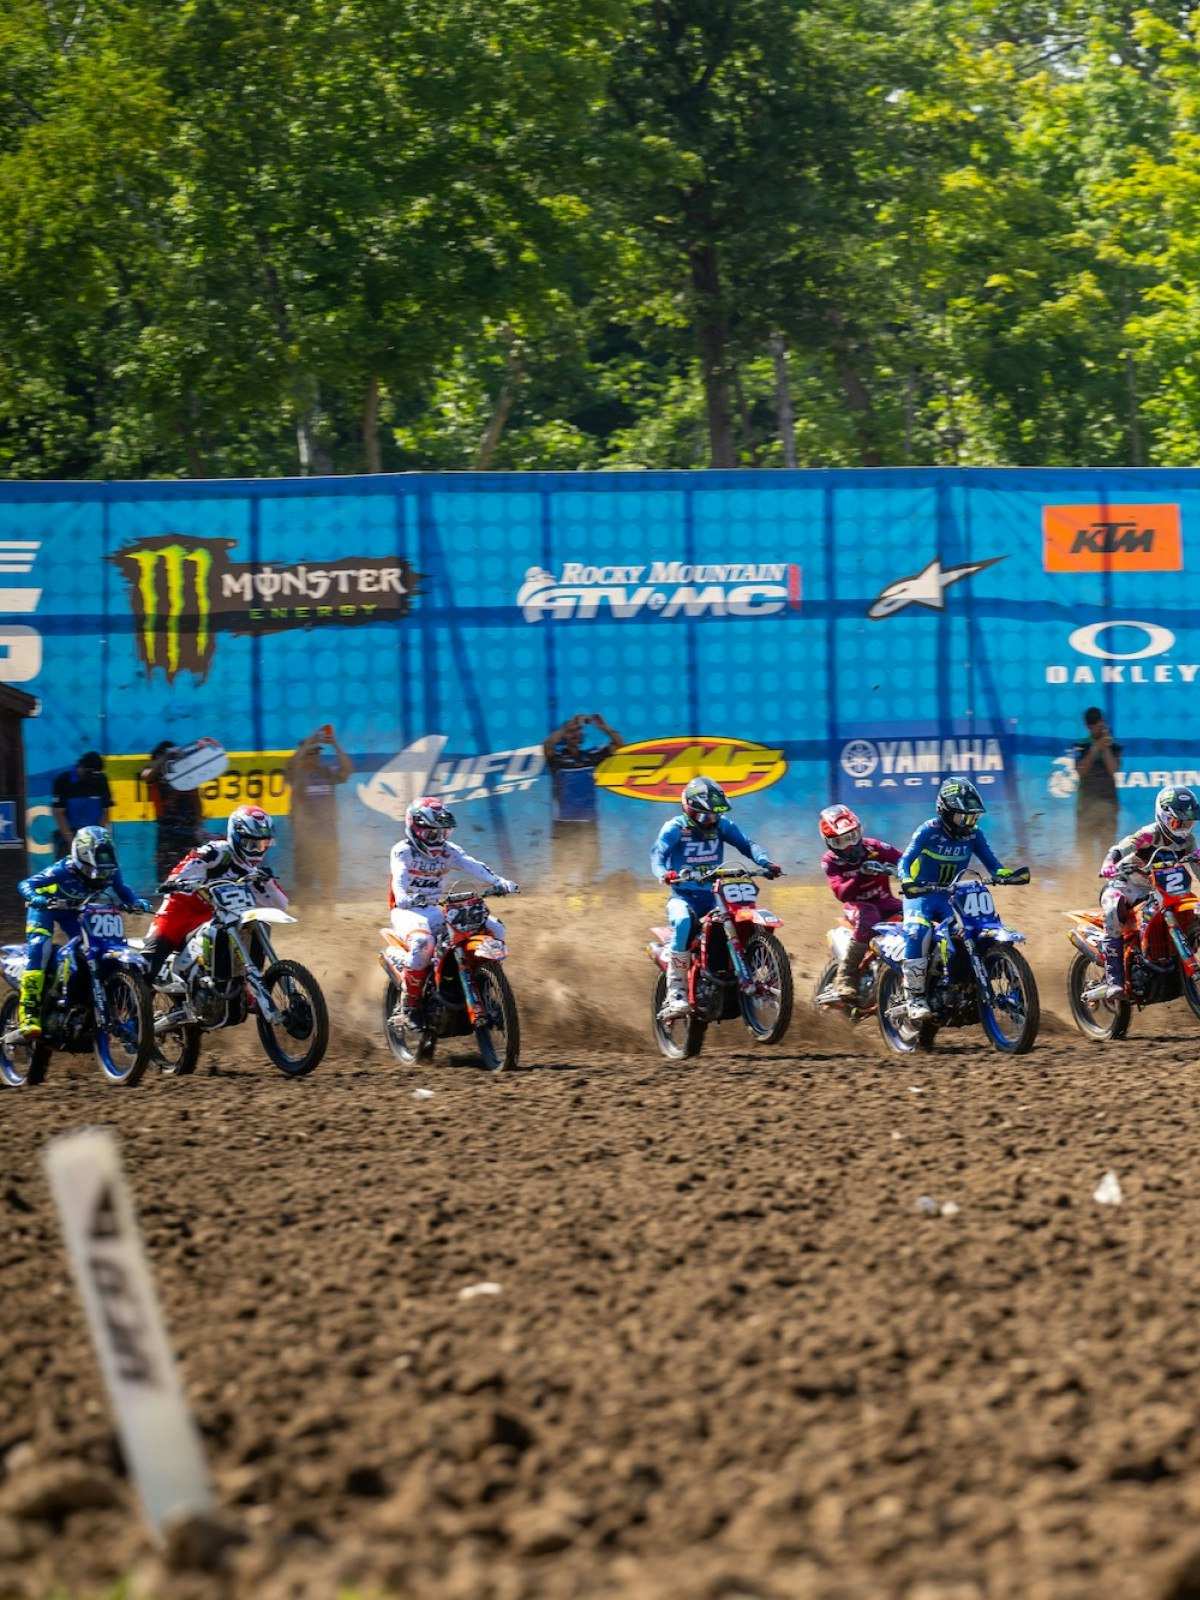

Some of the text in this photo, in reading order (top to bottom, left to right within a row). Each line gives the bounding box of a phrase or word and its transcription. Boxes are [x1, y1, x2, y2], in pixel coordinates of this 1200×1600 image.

[1070, 522, 1155, 553] KTM
[221, 565, 408, 601] MONSTER
[558, 561, 788, 585] ROCKY MOUNTAIN
[251, 604, 377, 619] ENERGY
[1045, 664, 1200, 683] OAKLEY
[594, 745, 784, 787] FMF
[877, 739, 1004, 774] YAMAHA
[441, 778, 540, 804] LAST
[855, 776, 996, 788] RACIG
[683, 839, 719, 856] FLY
[410, 877, 440, 888] KTM
[722, 883, 758, 904] 62
[1165, 872, 1184, 894] 2
[963, 892, 995, 918] 40
[90, 914, 125, 938] 260
